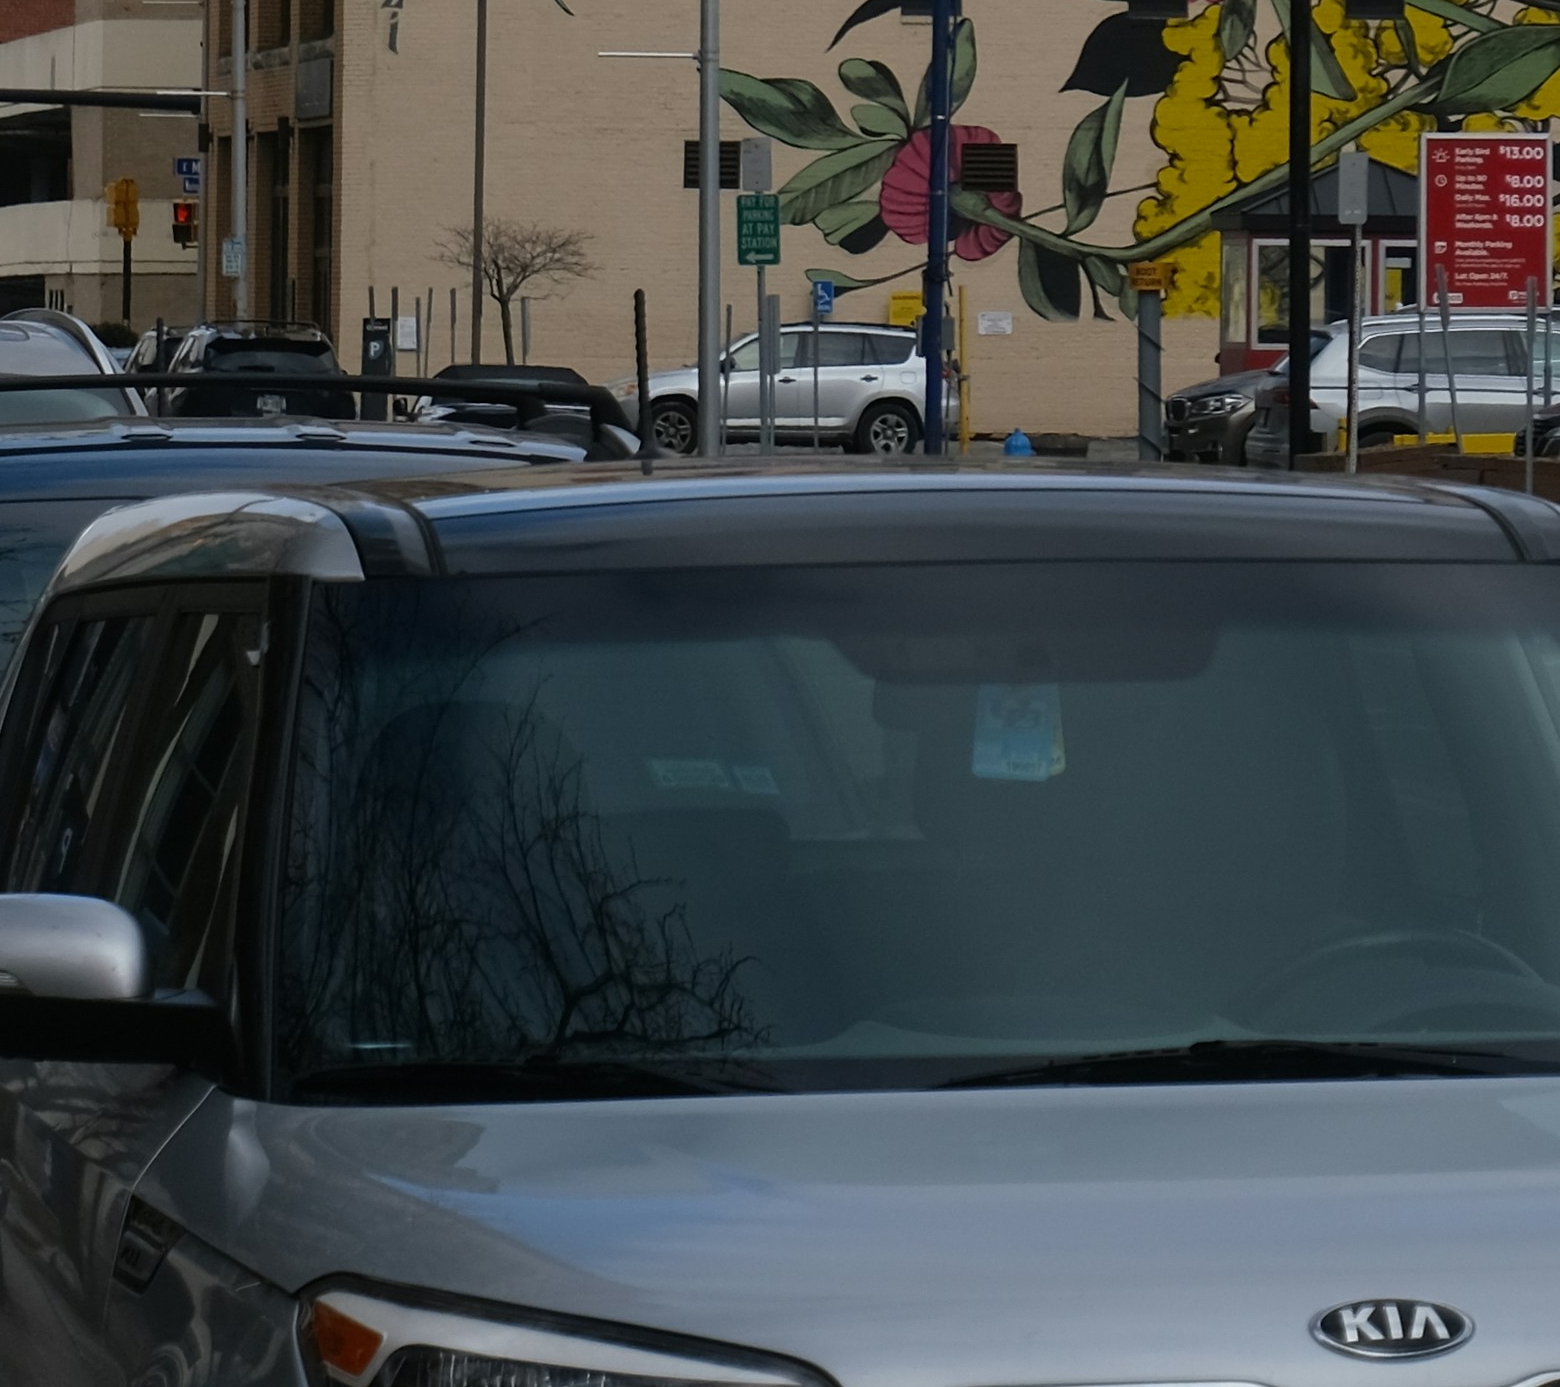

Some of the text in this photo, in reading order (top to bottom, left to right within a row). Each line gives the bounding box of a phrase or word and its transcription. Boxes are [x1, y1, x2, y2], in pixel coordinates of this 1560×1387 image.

[1500, 145, 1543, 159] $13.00
[1505, 175, 1544, 188] $8.00
[1499, 194, 1544, 207] $16.00
[1505, 213, 1544, 227] $8.00
[742, 223, 775, 235] AT PAY
[741, 237, 778, 249] STATION
[1339, 1306, 1451, 1343] KIA
